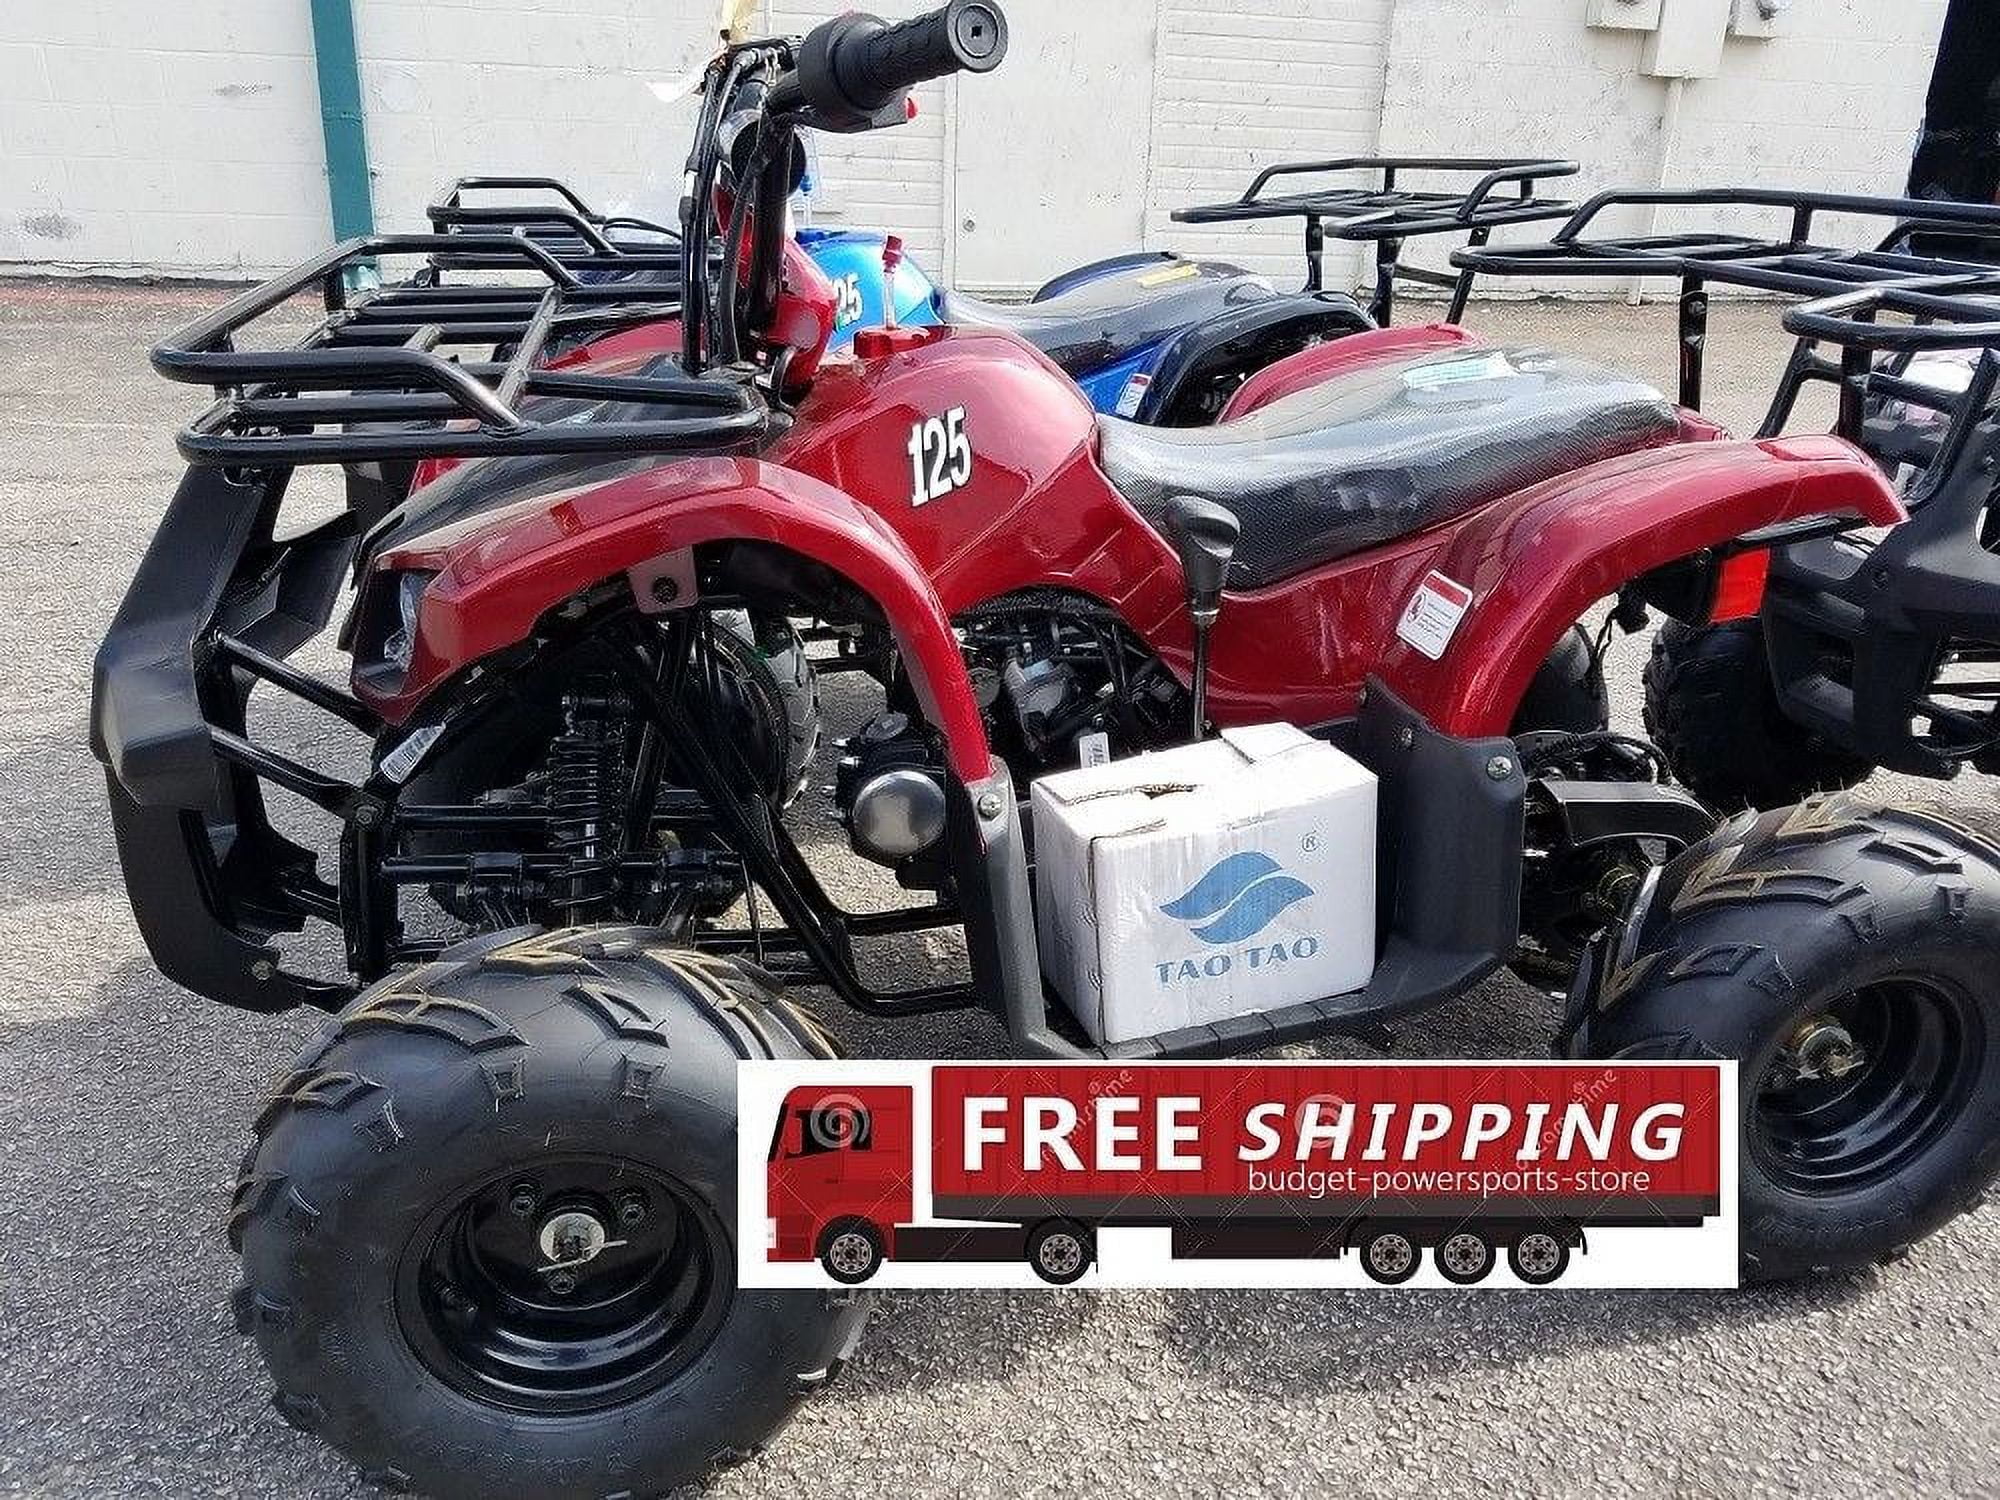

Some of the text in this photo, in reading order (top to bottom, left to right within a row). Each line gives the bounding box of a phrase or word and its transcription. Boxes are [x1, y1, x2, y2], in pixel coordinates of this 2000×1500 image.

[833, 272, 863, 330] 25
[907, 403, 973, 508] 125
[1155, 936, 1319, 983] TAO TAO
